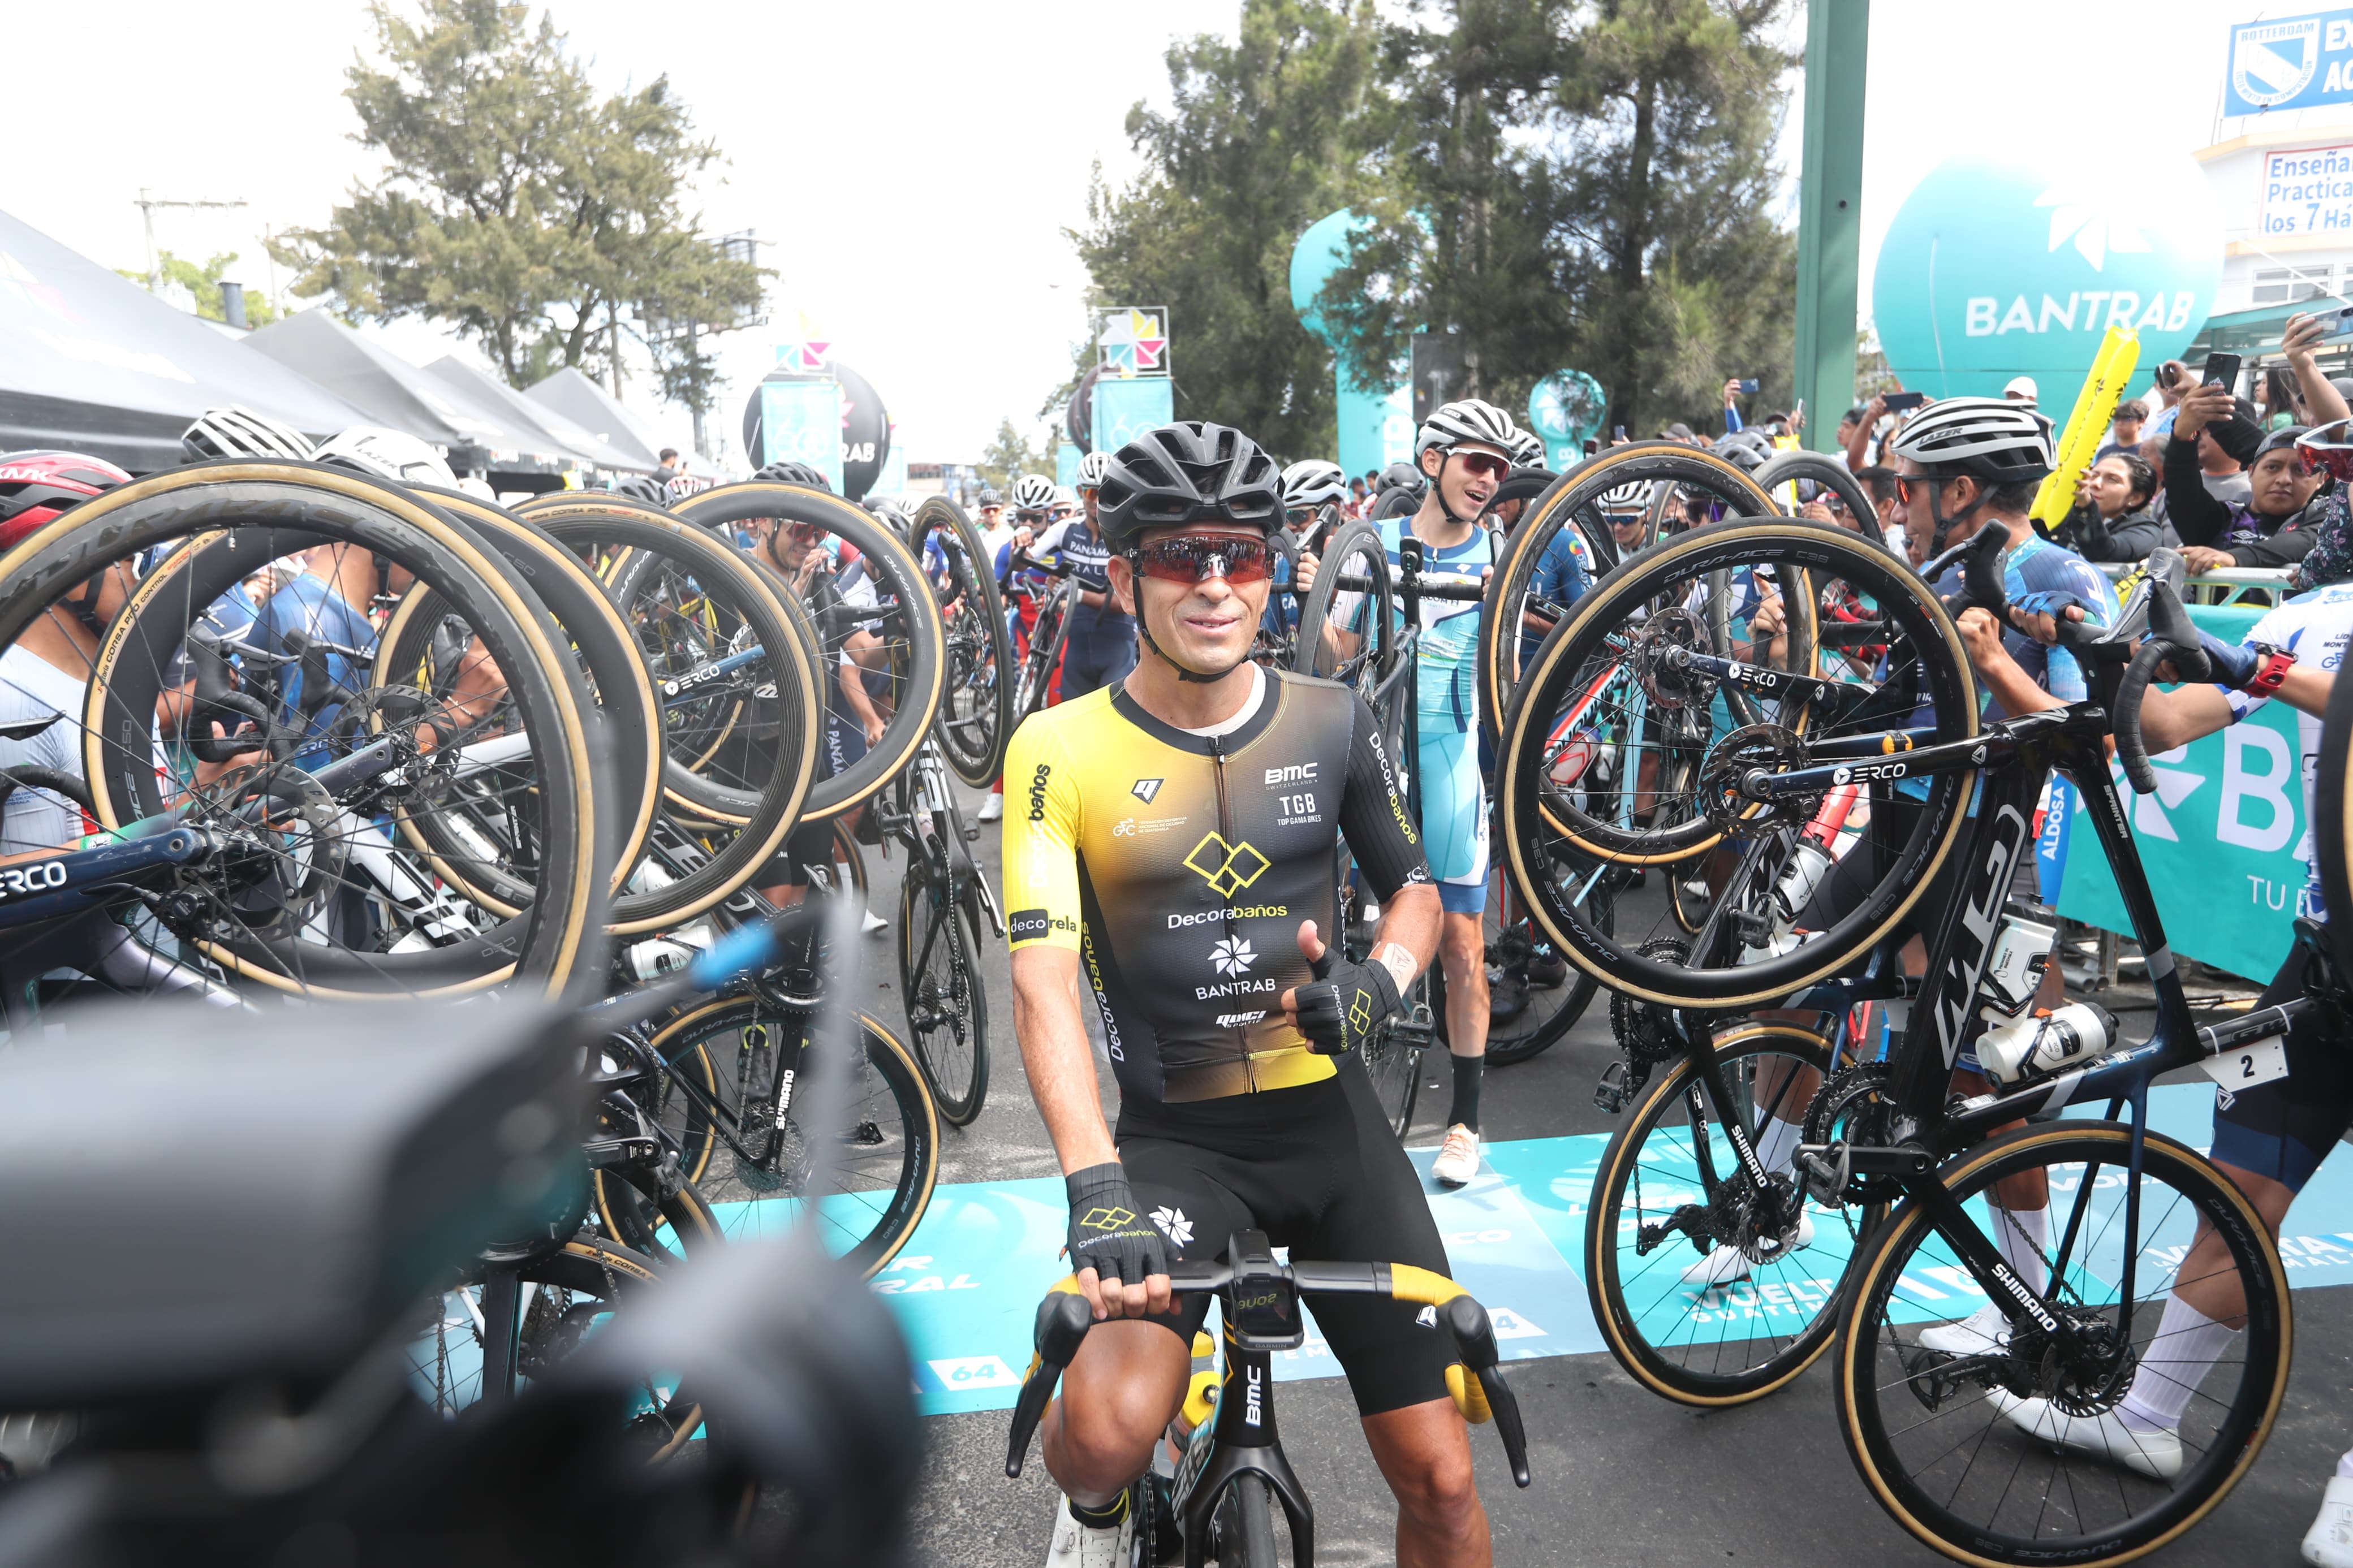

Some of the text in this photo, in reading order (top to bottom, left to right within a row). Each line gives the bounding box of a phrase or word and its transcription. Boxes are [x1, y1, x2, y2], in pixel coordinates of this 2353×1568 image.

[2241, 23, 2315, 42] ROTTERDAM
[2265, 213, 2295, 234] los
[2306, 202, 2320, 231] 7
[1965, 291, 2195, 338] BANTRAB
[1919, 426, 1963, 446] LAZER
[355, 448, 398, 470] LAZER
[2232, 537, 2255, 545] umbro
[618, 549, 653, 604] DURA-A
[1663, 547, 1830, 584] DURA-ACE C38
[883, 555, 924, 629] DURA-ACE
[106, 627, 126, 663] CORSA
[140, 573, 168, 603] CONTROL
[680, 664, 721, 690] ERCO
[1265, 762, 1318, 785] BMC
[1266, 779, 1313, 791] SWITZERLAND
[1852, 762, 1907, 781] ERCO
[1369, 731, 1416, 845] Decorabaños
[1277, 814, 1322, 827] TOP GAMA BIKES
[1279, 793, 1317, 816] TGB
[2103, 783, 2129, 840] SPRINTER
[1903, 773, 1954, 887] DURA-ACE
[2041, 785, 2065, 861] ALDOSA
[1529, 837, 1619, 962] C38 DURA-ACE
[2246, 874, 2286, 912] TU
[1010, 914, 1077, 934] decorela
[1168, 904, 1287, 930] Decorabaños
[1082, 921, 1126, 1062] Decorabaños
[1195, 978, 1277, 1000] BANTRAB
[2240, 1055, 2255, 1078] 2
[600, 1099, 638, 1123] ULTEG
[774, 1069, 795, 1130] SHIMANO
[1731, 1124, 1768, 1189] SHIMANO
[899, 1135, 921, 1215] DURA-ACE
[1078, 1229, 1157, 1249] Decorabaños
[2208, 1198, 2267, 1289] DURA-ACE
[613, 1259, 647, 1278] CORSA
[1680, 1278, 1834, 1311] VUELT
[1990, 1262, 2058, 1333] SHIMANO
[1691, 1300, 1826, 1324] GUATEM
[951, 1364, 998, 1382] 64
[1244, 1364, 1262, 1427] BMC
